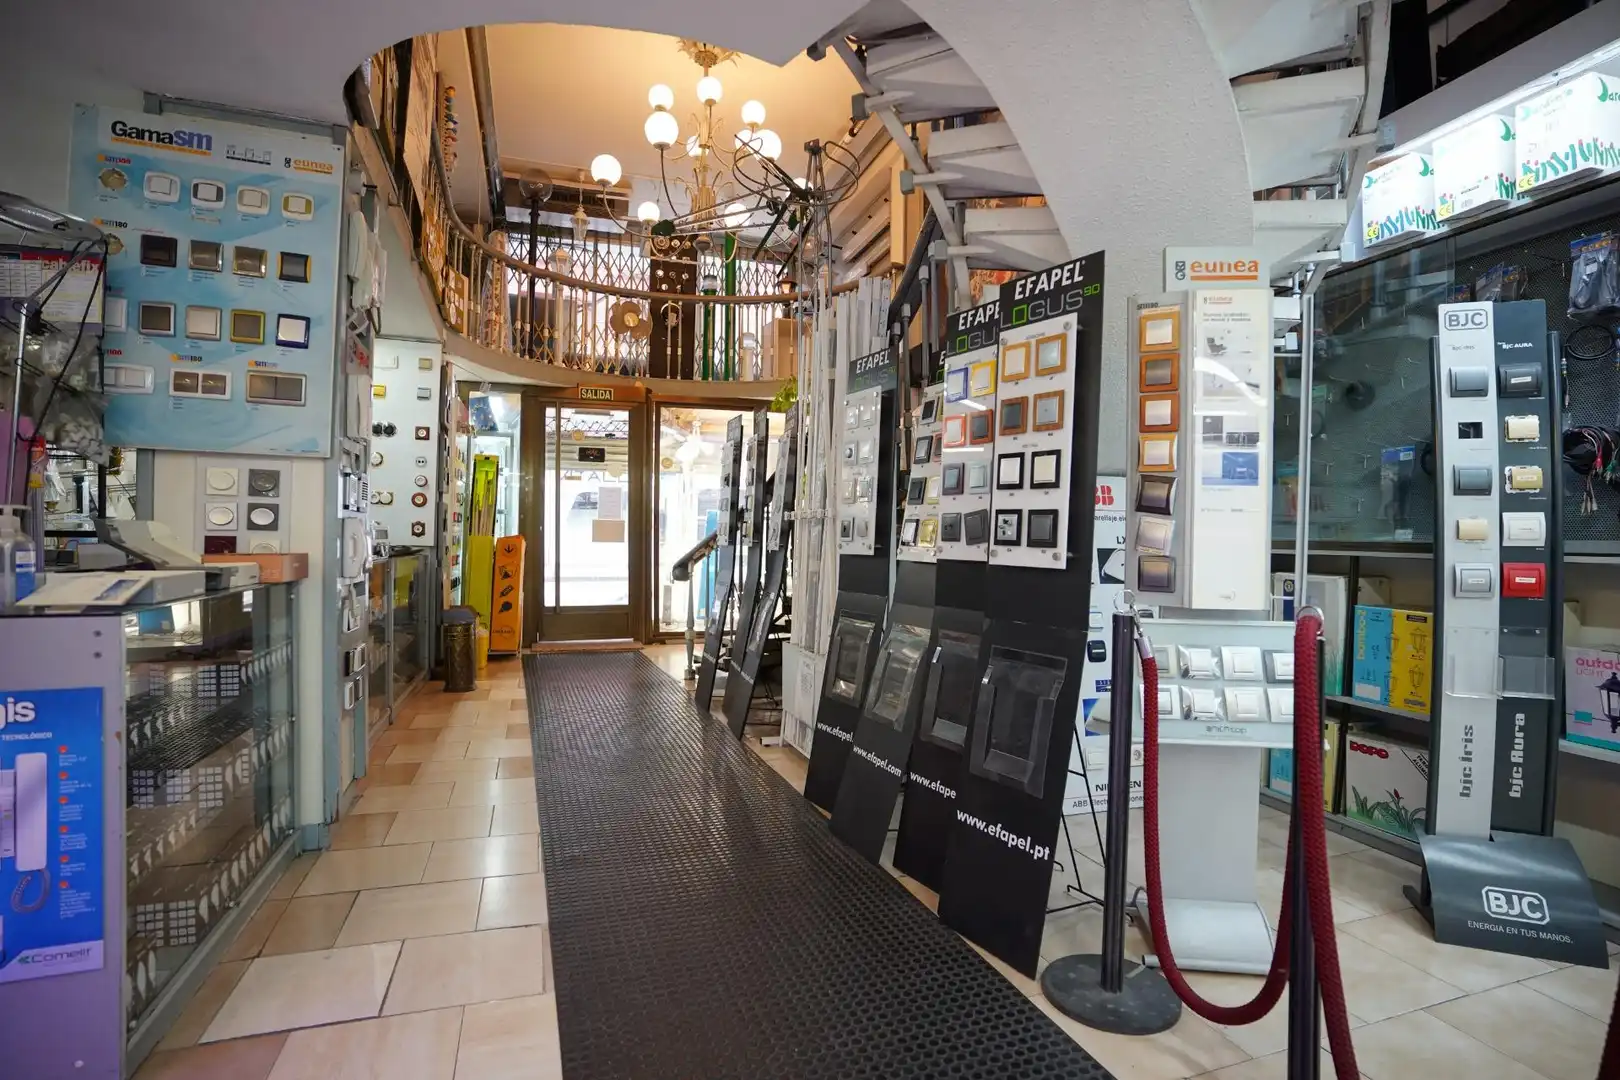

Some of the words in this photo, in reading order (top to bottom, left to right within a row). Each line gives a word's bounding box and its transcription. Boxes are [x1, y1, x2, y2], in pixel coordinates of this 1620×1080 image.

[1015, 261, 1084, 300] EFAPEL
[1190, 260, 1259, 273] eunea
[1448, 312, 1484, 328] BJC
[856, 348, 890, 374] EFAPEL
[581, 388, 611, 400] SALIDA
[1459, 724, 1474, 763] iris
[853, 744, 902, 777] www.efapel.com
[1459, 766, 1474, 798] bjc
[1508, 766, 1524, 798] bjc
[956, 809, 1051, 861] www.efapel.pt
[1488, 891, 1544, 919] BJC
[1506, 926, 1518, 935] EN
[1519, 928, 1538, 938] TUS
[1539, 931, 1574, 944] MANOS.
[31, 947, 93, 965] Comelit
